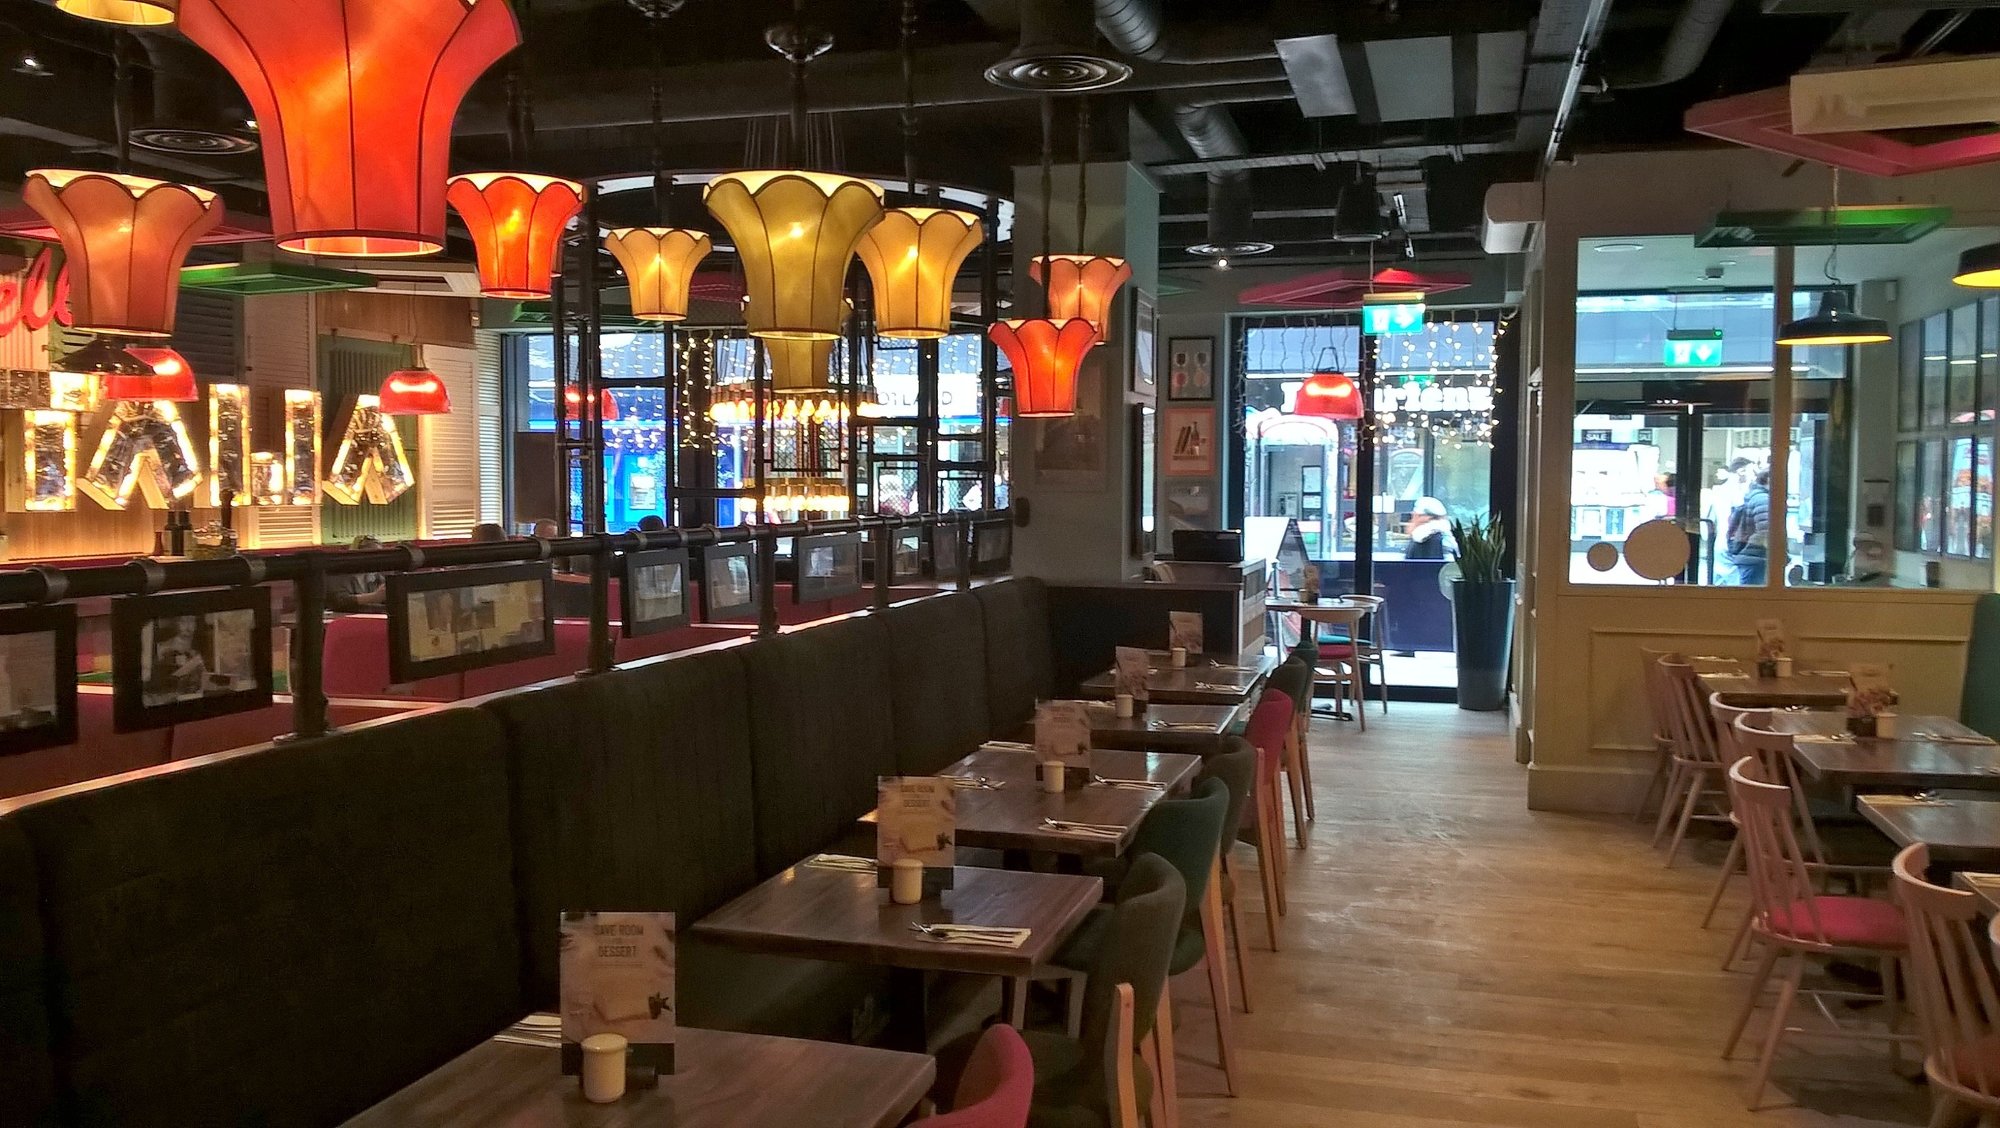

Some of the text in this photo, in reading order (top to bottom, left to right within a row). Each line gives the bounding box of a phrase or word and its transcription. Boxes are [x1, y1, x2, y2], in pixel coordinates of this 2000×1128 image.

[1585, 432, 1608, 441] SALE
[593, 924, 644, 937] SAVE ROOM
[598, 945, 637, 958] DESSERT
